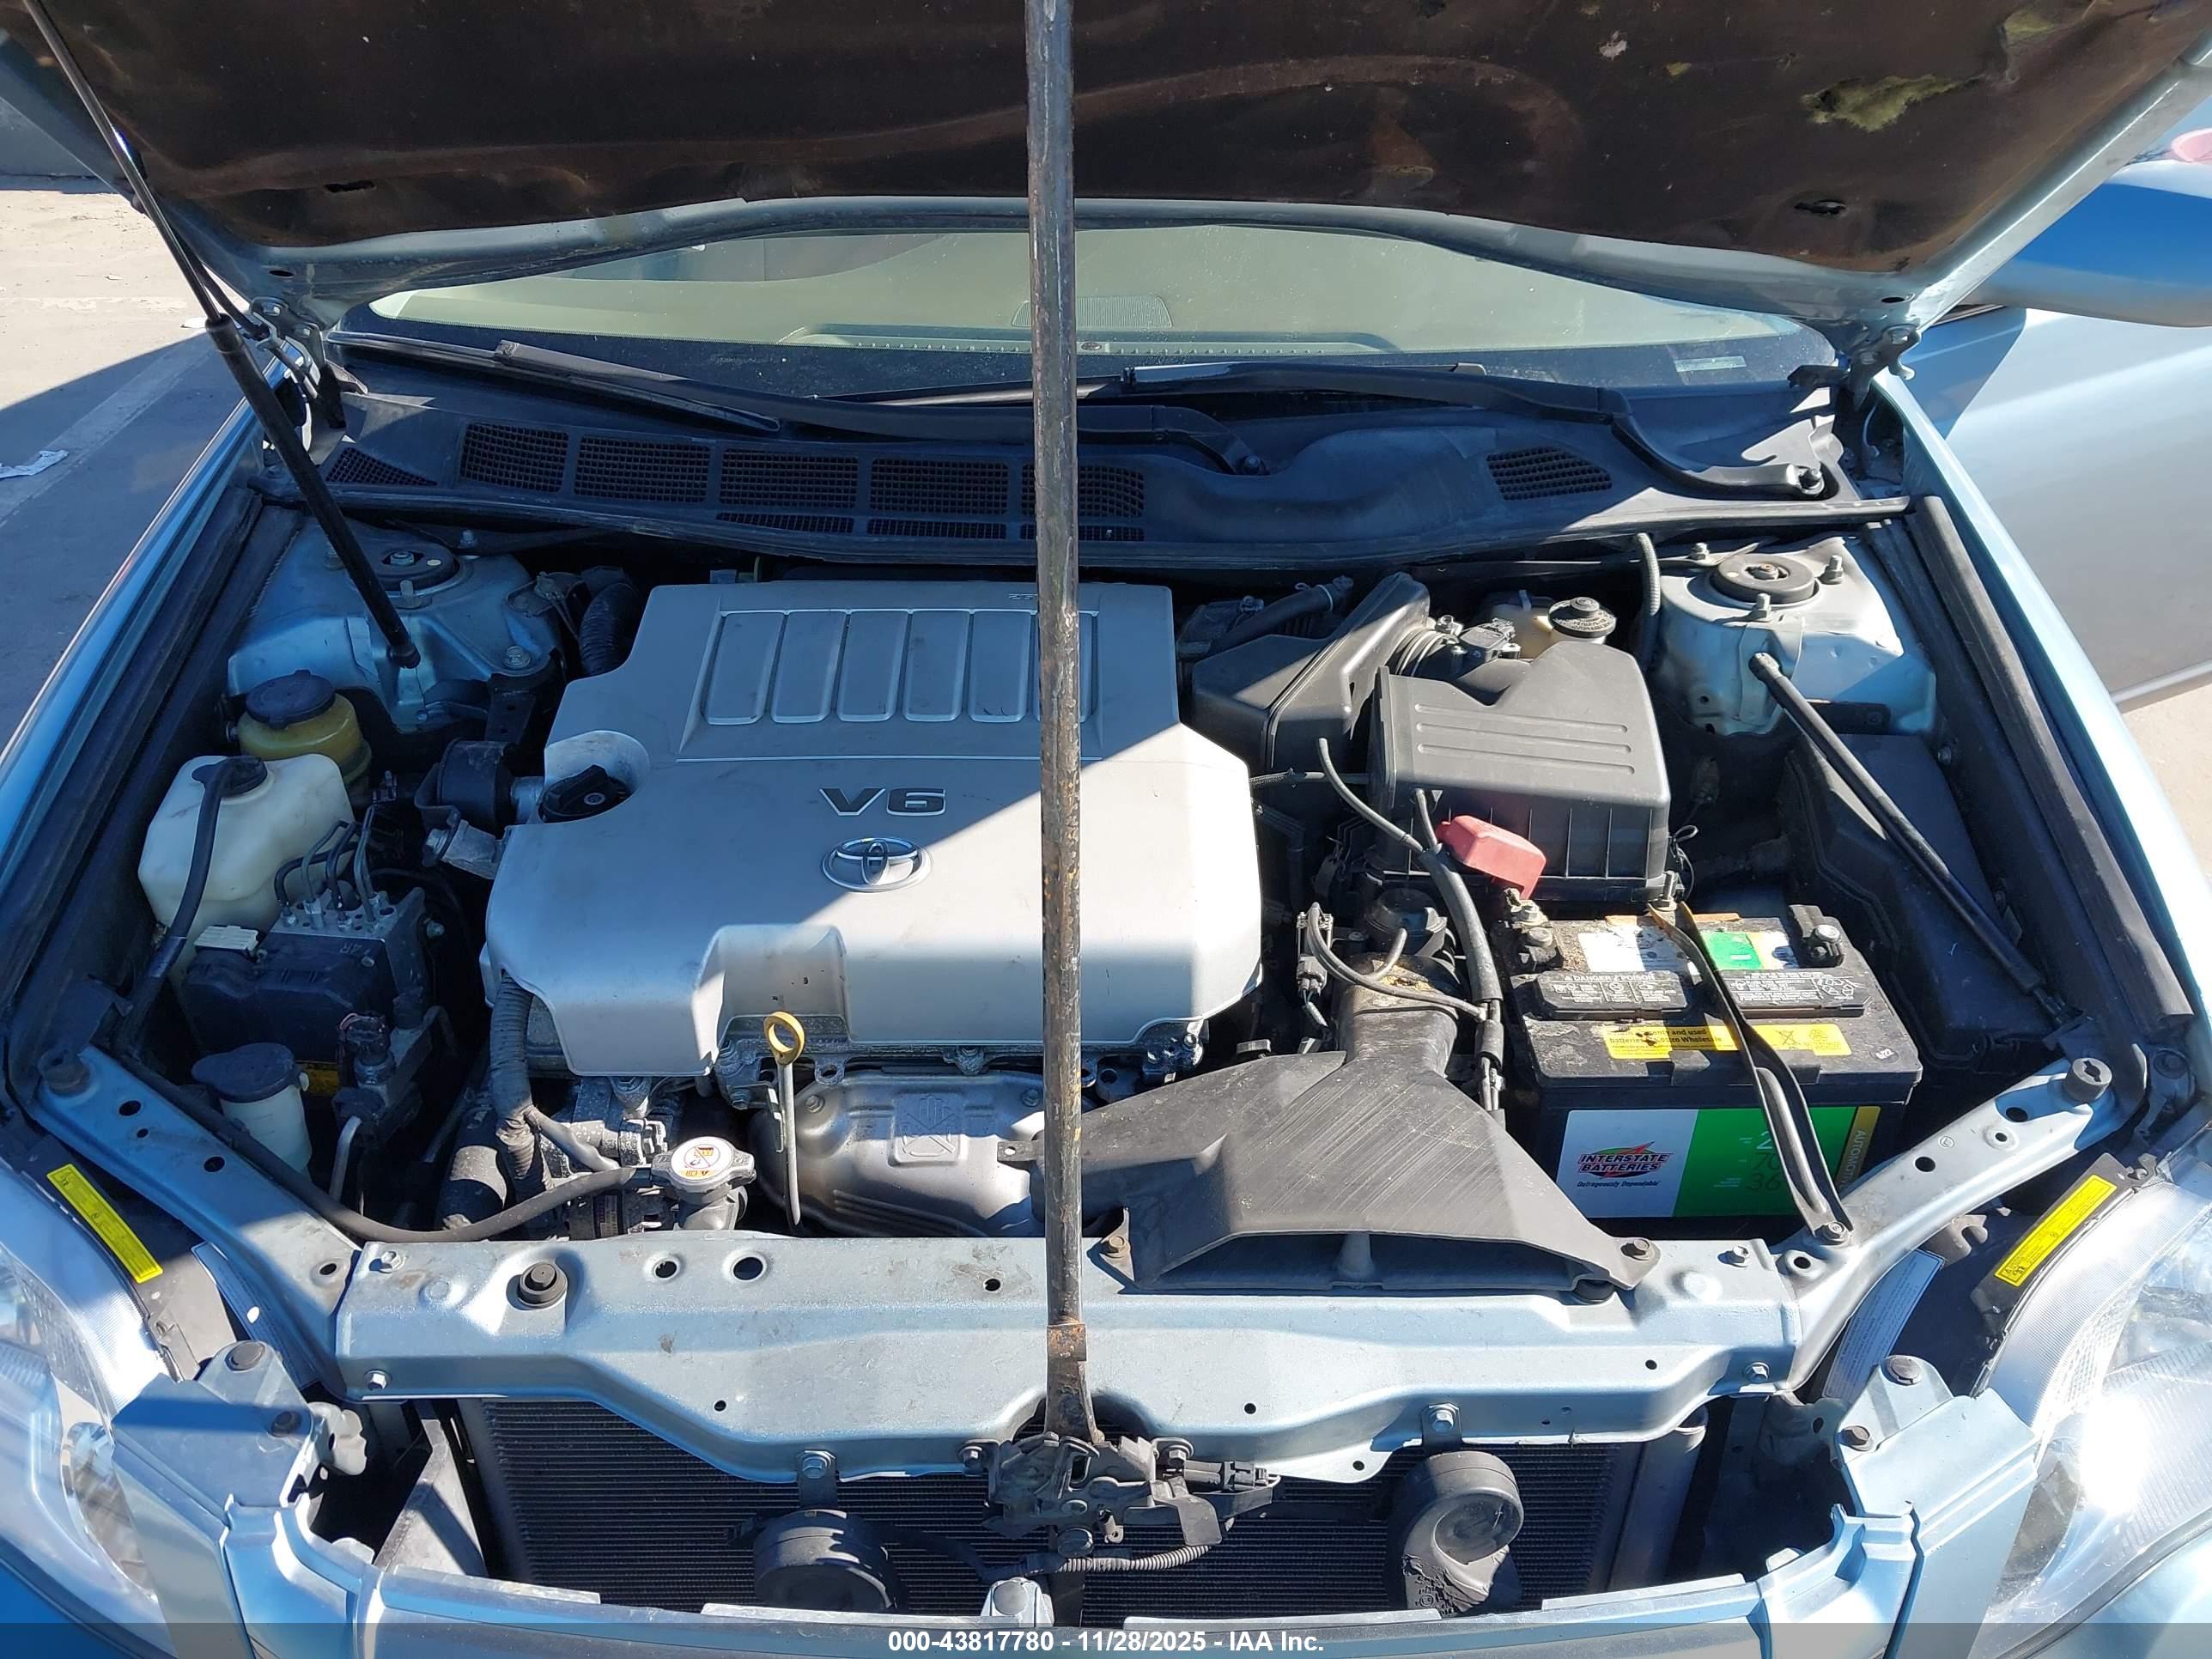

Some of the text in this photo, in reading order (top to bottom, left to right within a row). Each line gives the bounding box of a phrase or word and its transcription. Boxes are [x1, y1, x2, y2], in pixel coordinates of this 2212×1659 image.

[817, 787, 946, 817] V6
[1581, 1154, 1668, 1163] INTERSTATE
[1581, 1162, 1659, 1172] BATTERIES
